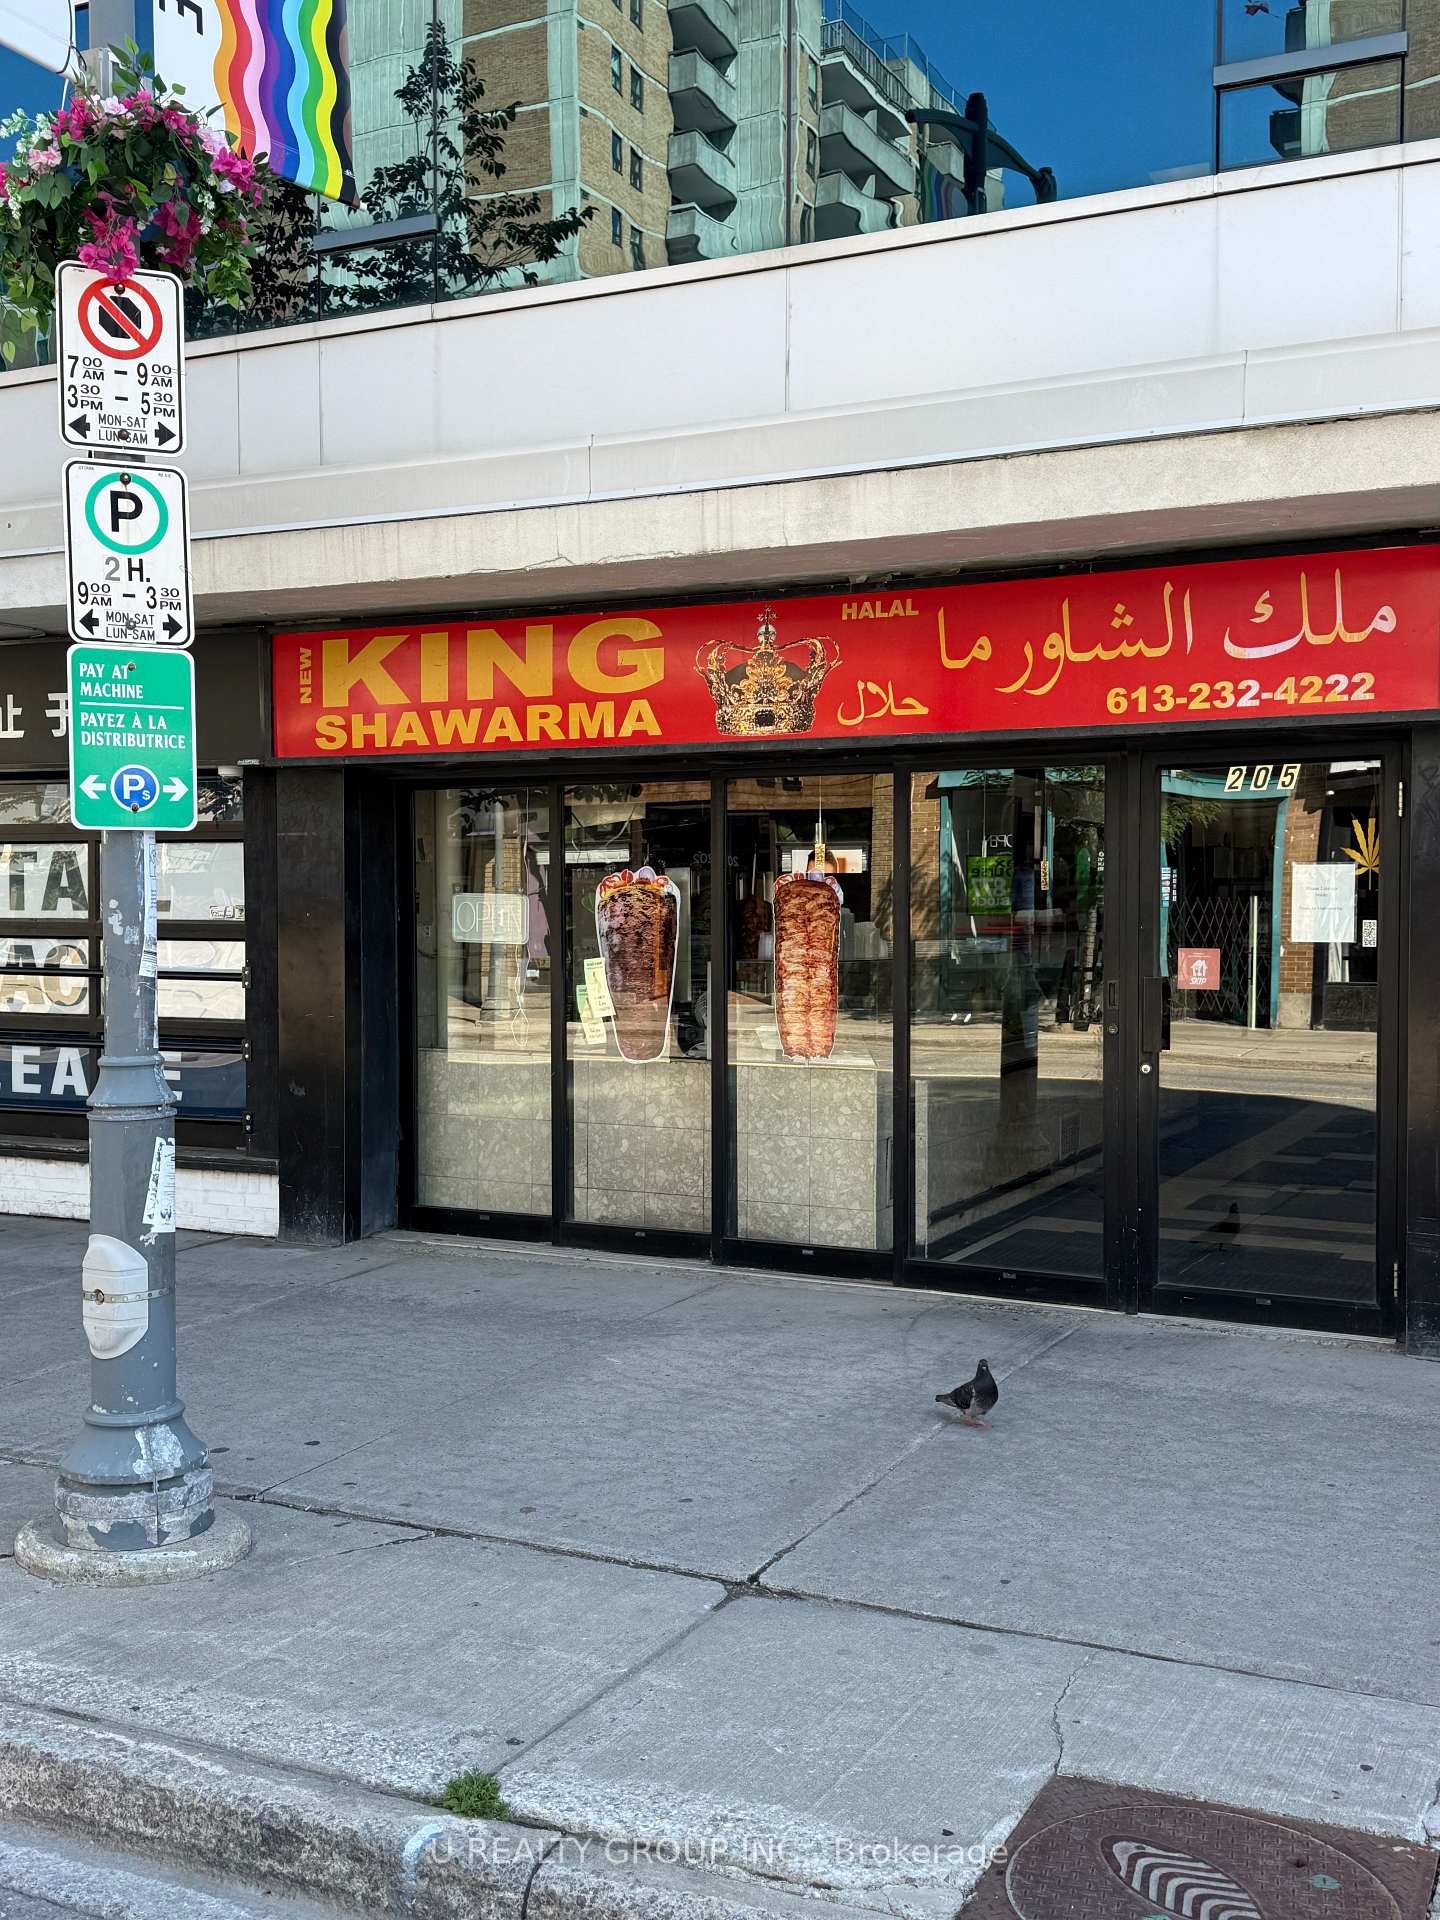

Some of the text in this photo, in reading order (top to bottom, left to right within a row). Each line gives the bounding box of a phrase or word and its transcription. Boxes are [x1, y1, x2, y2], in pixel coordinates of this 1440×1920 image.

[82, 370, 173, 388] AM AM
[81, 400, 176, 418] PM PM
[98, 413, 148, 429] MON-SAT
[98, 429, 148, 444] LUNSAM
[110, 490, 143, 532] P
[105, 556, 150, 582] 2 H.
[91, 596, 182, 611] AM PM
[841, 599, 919, 620] HALAL
[1223, 568, 1398, 660] ملك
[106, 626, 155, 641] LUN-SAM
[79, 663, 128, 680] PAY AT
[322, 617, 665, 707] KING
[299, 647, 312, 704] NEW
[80, 682, 144, 699] MACHINE
[1106, 671, 1376, 715] 613-232-4222
[836, 680, 929, 726] حلال
[80, 712, 167, 730] PAYEZ À LA
[314, 698, 663, 751] SHAWARMA
[81, 732, 186, 749] DISTRIBUTRICE
[1227, 765, 1298, 790] 205
